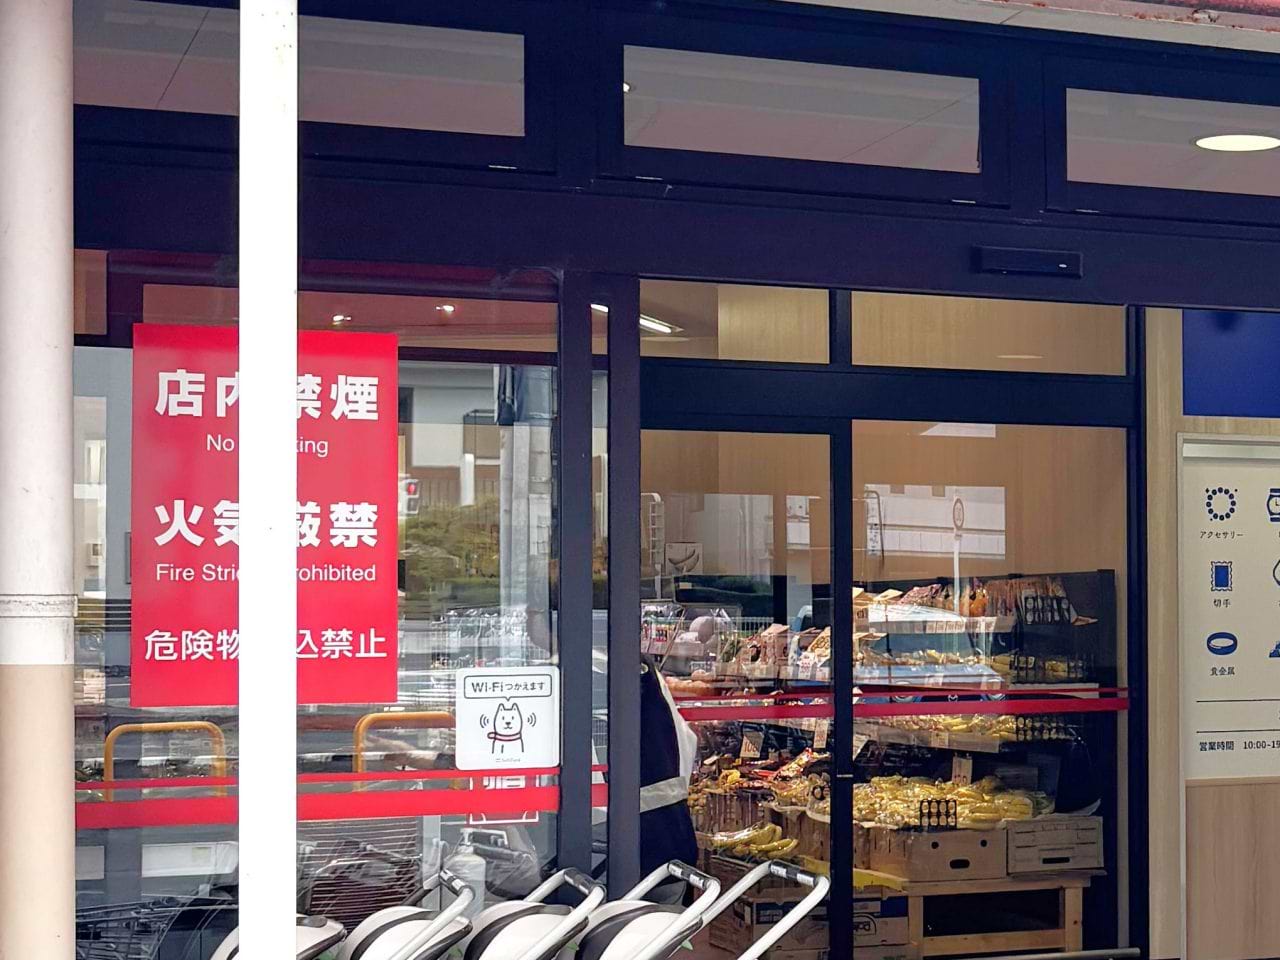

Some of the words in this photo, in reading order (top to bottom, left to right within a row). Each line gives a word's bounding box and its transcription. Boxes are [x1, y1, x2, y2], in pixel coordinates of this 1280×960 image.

[206, 433, 235, 452] No
[1200, 531, 1244, 539] アクセサリー
[156, 564, 195, 581] Fire
[144, 628, 388, 661] 危険物込禁止
[471, 681, 545, 693] Wi-Fiつかえます
[1199, 741, 1234, 751] 営業時間
